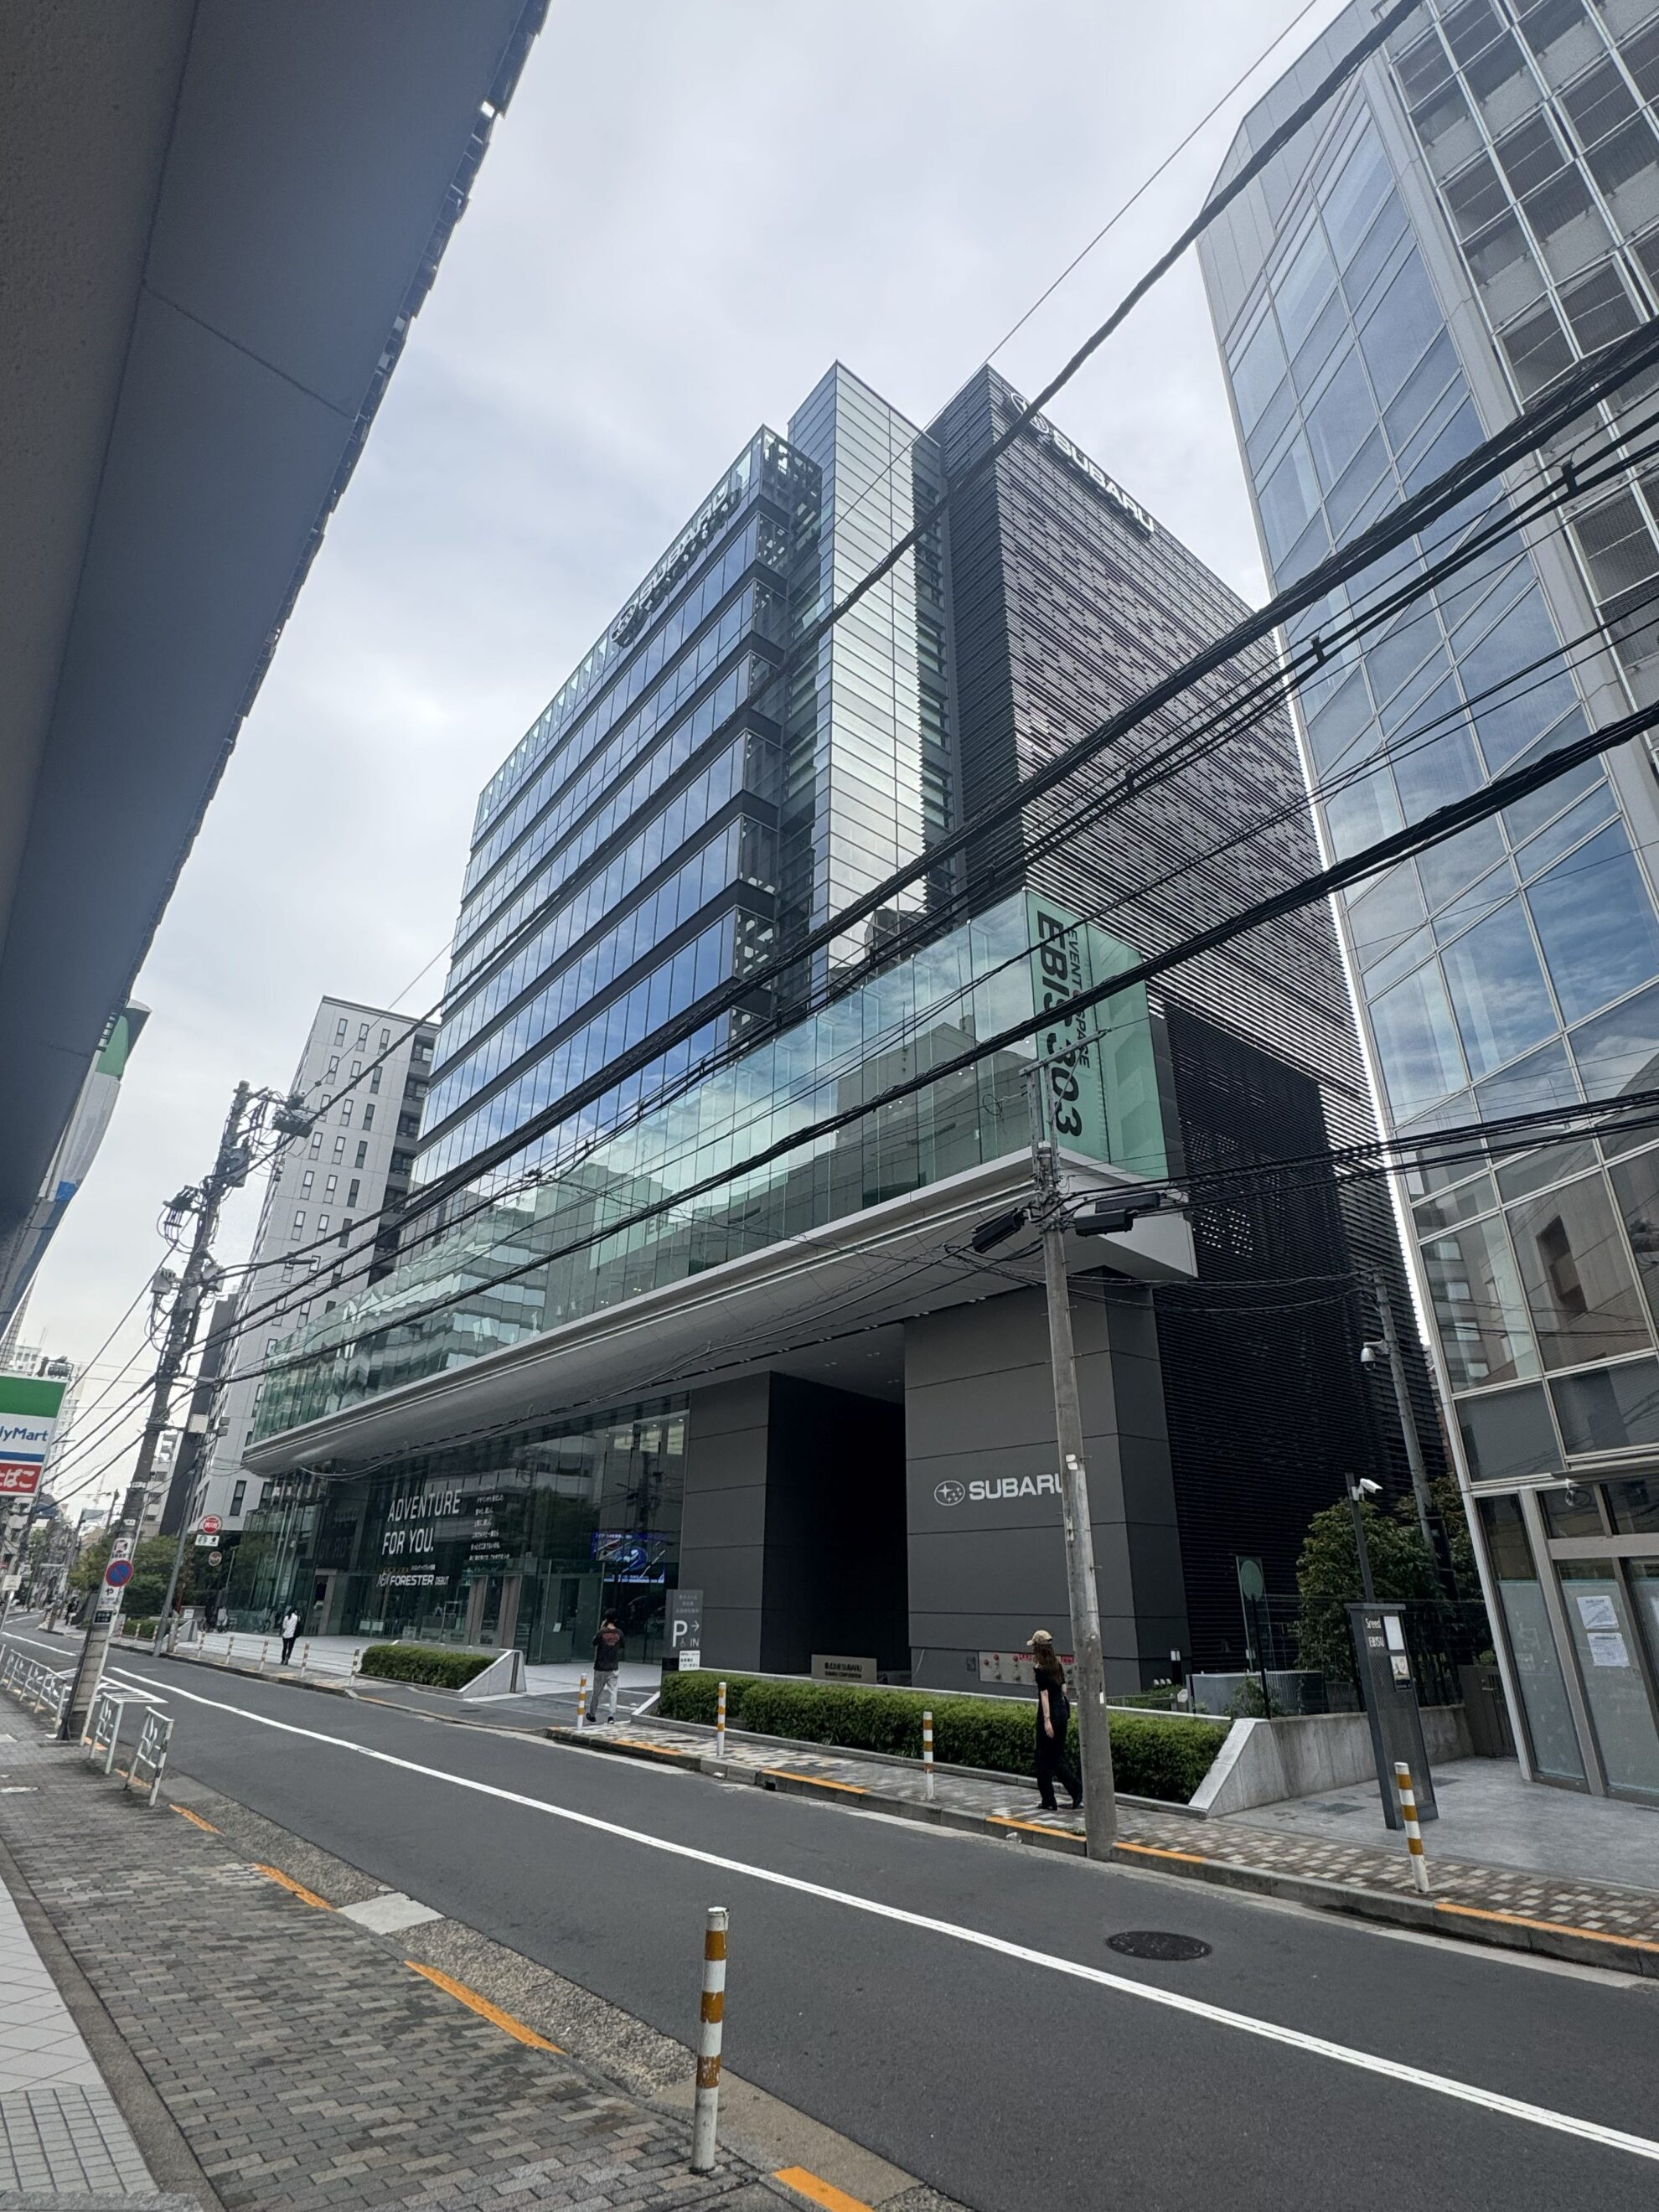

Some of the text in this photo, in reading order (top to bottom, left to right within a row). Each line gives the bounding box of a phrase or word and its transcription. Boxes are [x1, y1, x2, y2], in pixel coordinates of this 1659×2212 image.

[1052, 429, 1155, 533] SUBARU
[638, 478, 731, 605] SUBARU
[1067, 928, 1083, 990] EVENT
[387, 1488, 462, 1522] ADVENTURE
[381, 1527, 434, 1556] FOR YOU.
[390, 1574, 435, 1586] FORESTER
[672, 1620, 688, 1648] P
[690, 1636, 700, 1648] IN
